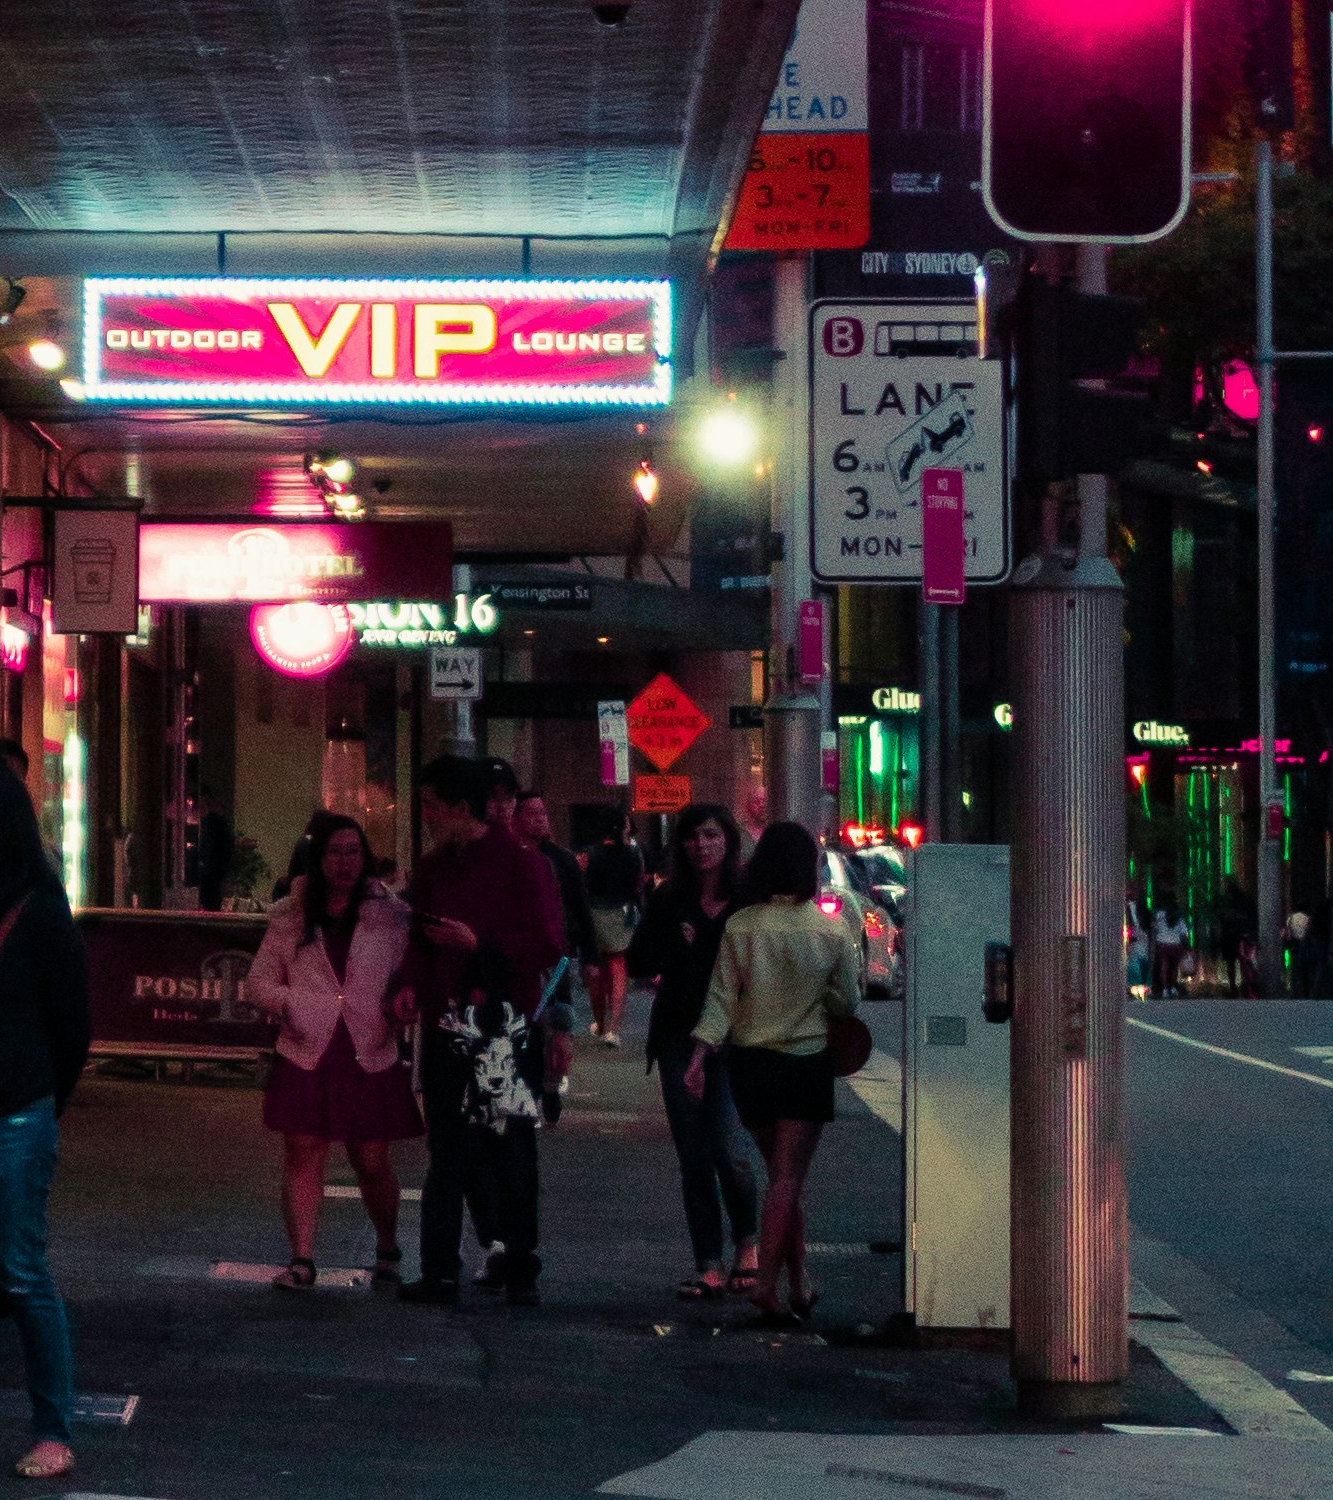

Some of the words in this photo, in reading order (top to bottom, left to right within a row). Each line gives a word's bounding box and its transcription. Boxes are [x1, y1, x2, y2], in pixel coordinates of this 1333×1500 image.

[765, 96, 847, 119] HEAD
[755, 184, 773, 208] 3
[812, 184, 832, 209] 7
[861, 251, 889, 274] CITY
[905, 252, 956, 274] SYDNEY
[106, 328, 262, 351] OUTDOOR
[267, 302, 497, 379] VIP
[513, 331, 646, 353] LOUNGE
[832, 320, 856, 354] B
[833, 439, 859, 473] 6
[936, 477, 949, 491] NO
[844, 486, 870, 520] 3
[927, 494, 959, 511] STOPPING
[454, 592, 497, 632] 16
[436, 657, 476, 674] WAY
[133, 974, 222, 1001] POSH
